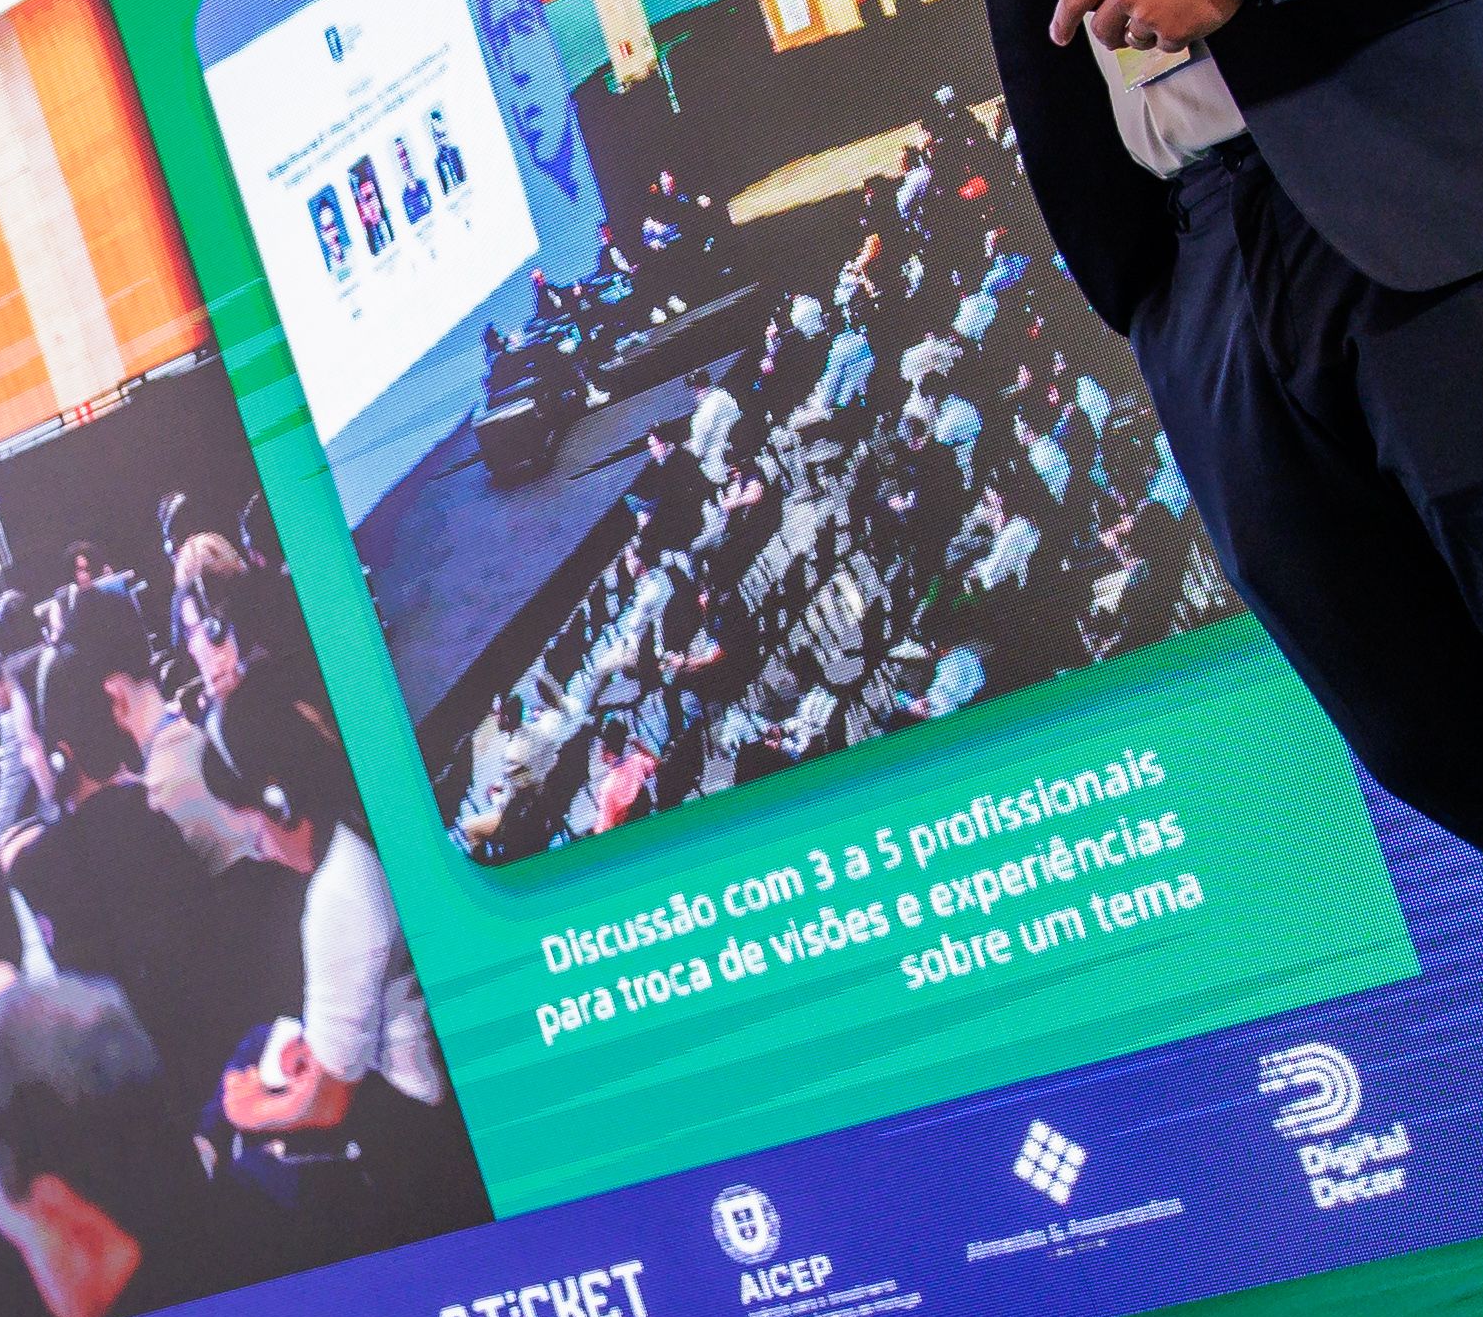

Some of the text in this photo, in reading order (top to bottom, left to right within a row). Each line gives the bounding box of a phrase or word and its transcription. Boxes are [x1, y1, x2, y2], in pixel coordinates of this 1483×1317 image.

[535, 805, 1186, 1046] para troca de visões e experiências
[541, 744, 1167, 976] Discussão com 3 a 5 profissionais
[900, 868, 1205, 991] sobre um tema
[738, 1254, 835, 1304] AICEP
